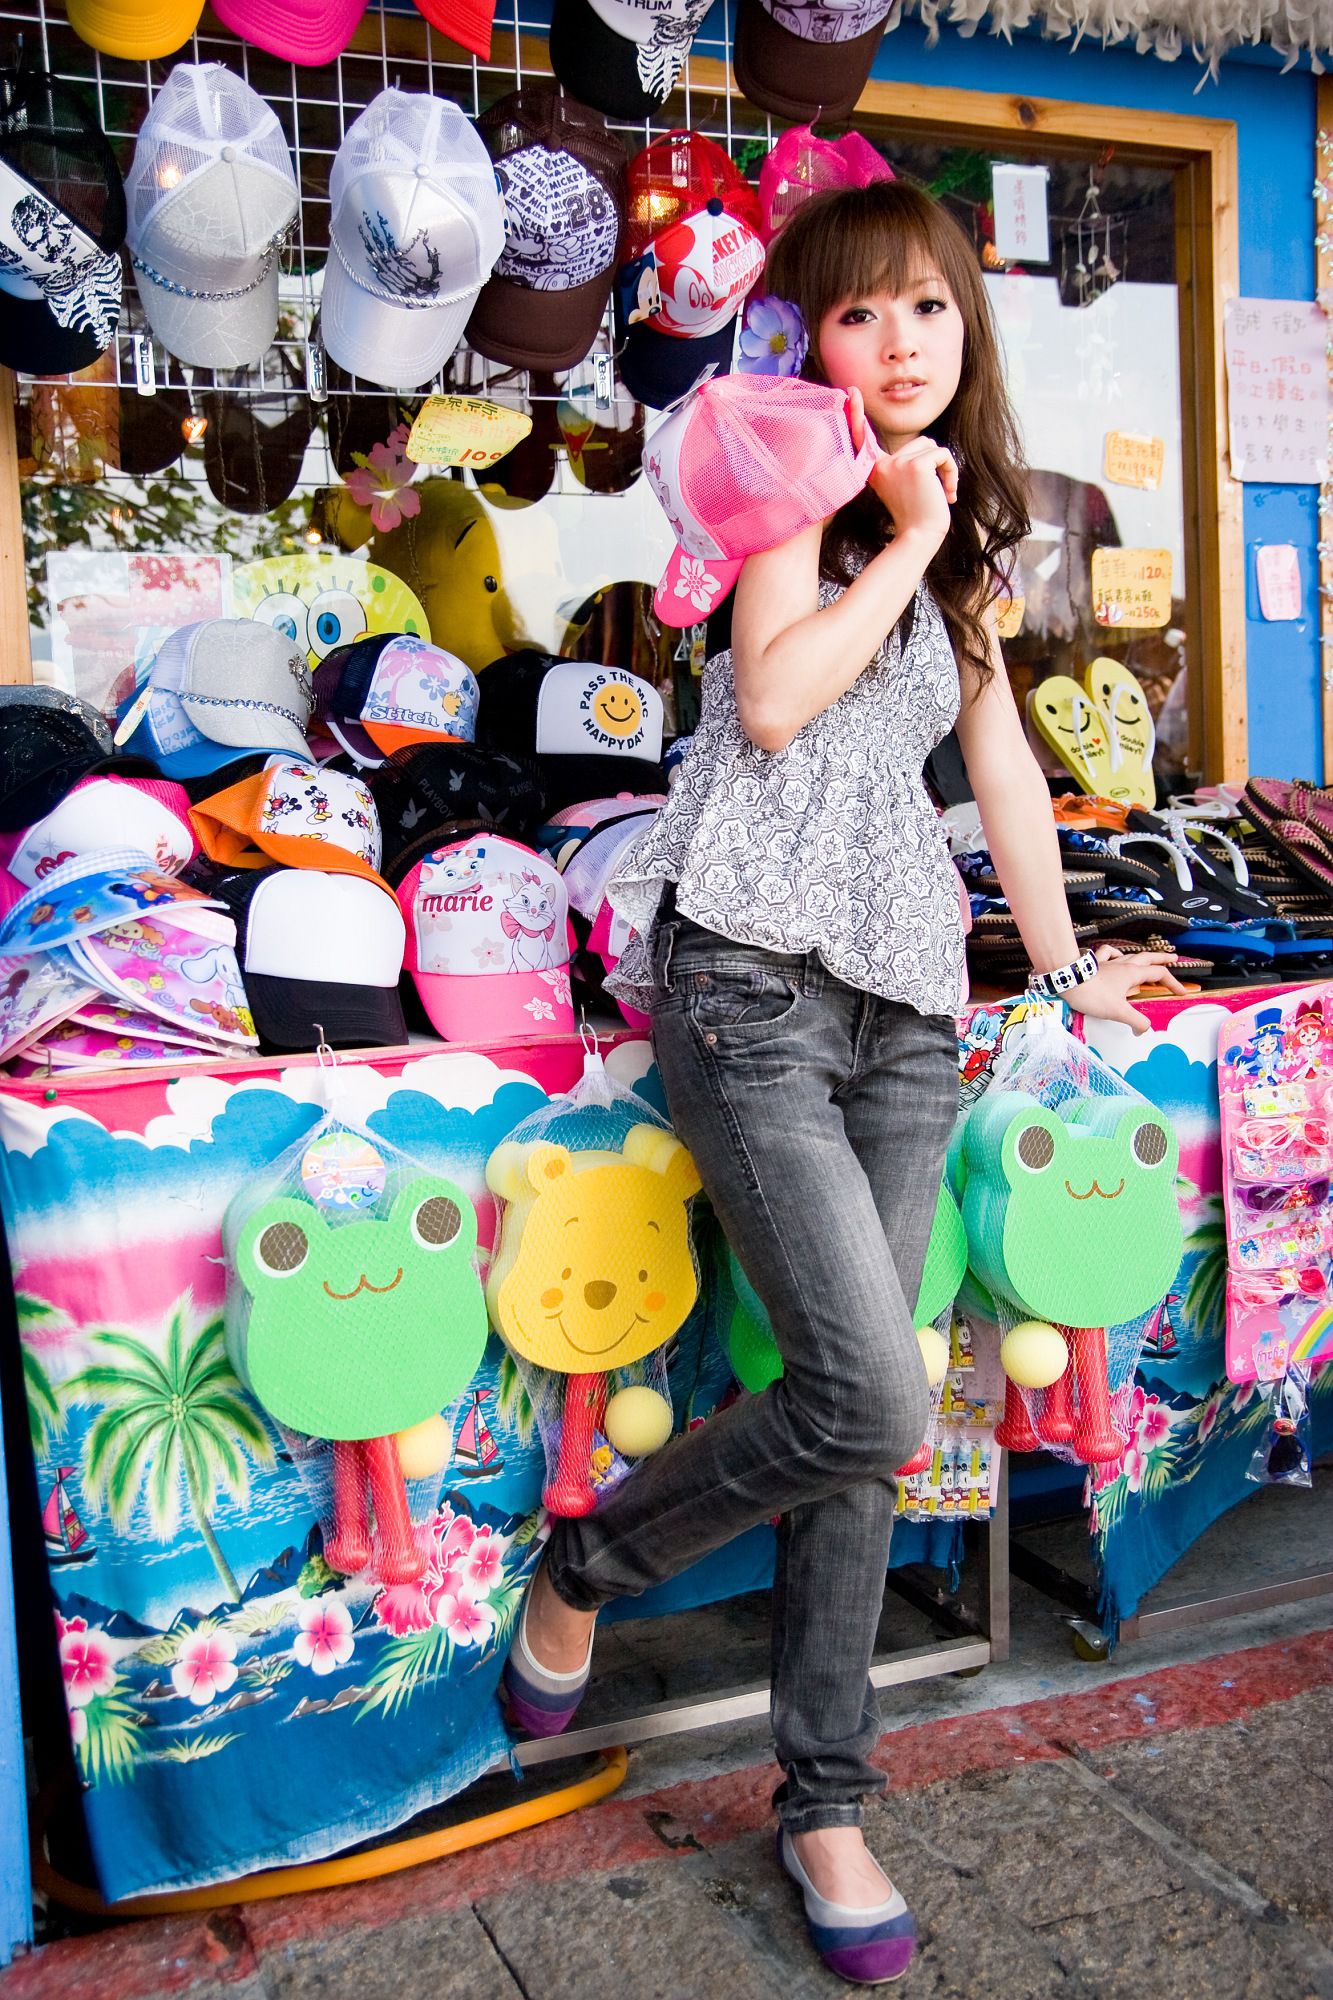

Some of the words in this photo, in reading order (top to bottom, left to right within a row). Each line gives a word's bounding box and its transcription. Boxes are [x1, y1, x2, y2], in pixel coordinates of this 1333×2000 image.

[549, 172, 584, 190] MICKEY
[566, 187, 609, 230] 28
[580, 675, 606, 710] PASS
[609, 672, 635, 688] THE
[370, 705, 439, 727] Stitch
[636, 687, 649, 718] MIC
[583, 719, 625, 750] HAPPY
[627, 727, 645, 749] DAY
[418, 778, 455, 818] PLAYBOY
[422, 895, 493, 912] marie
